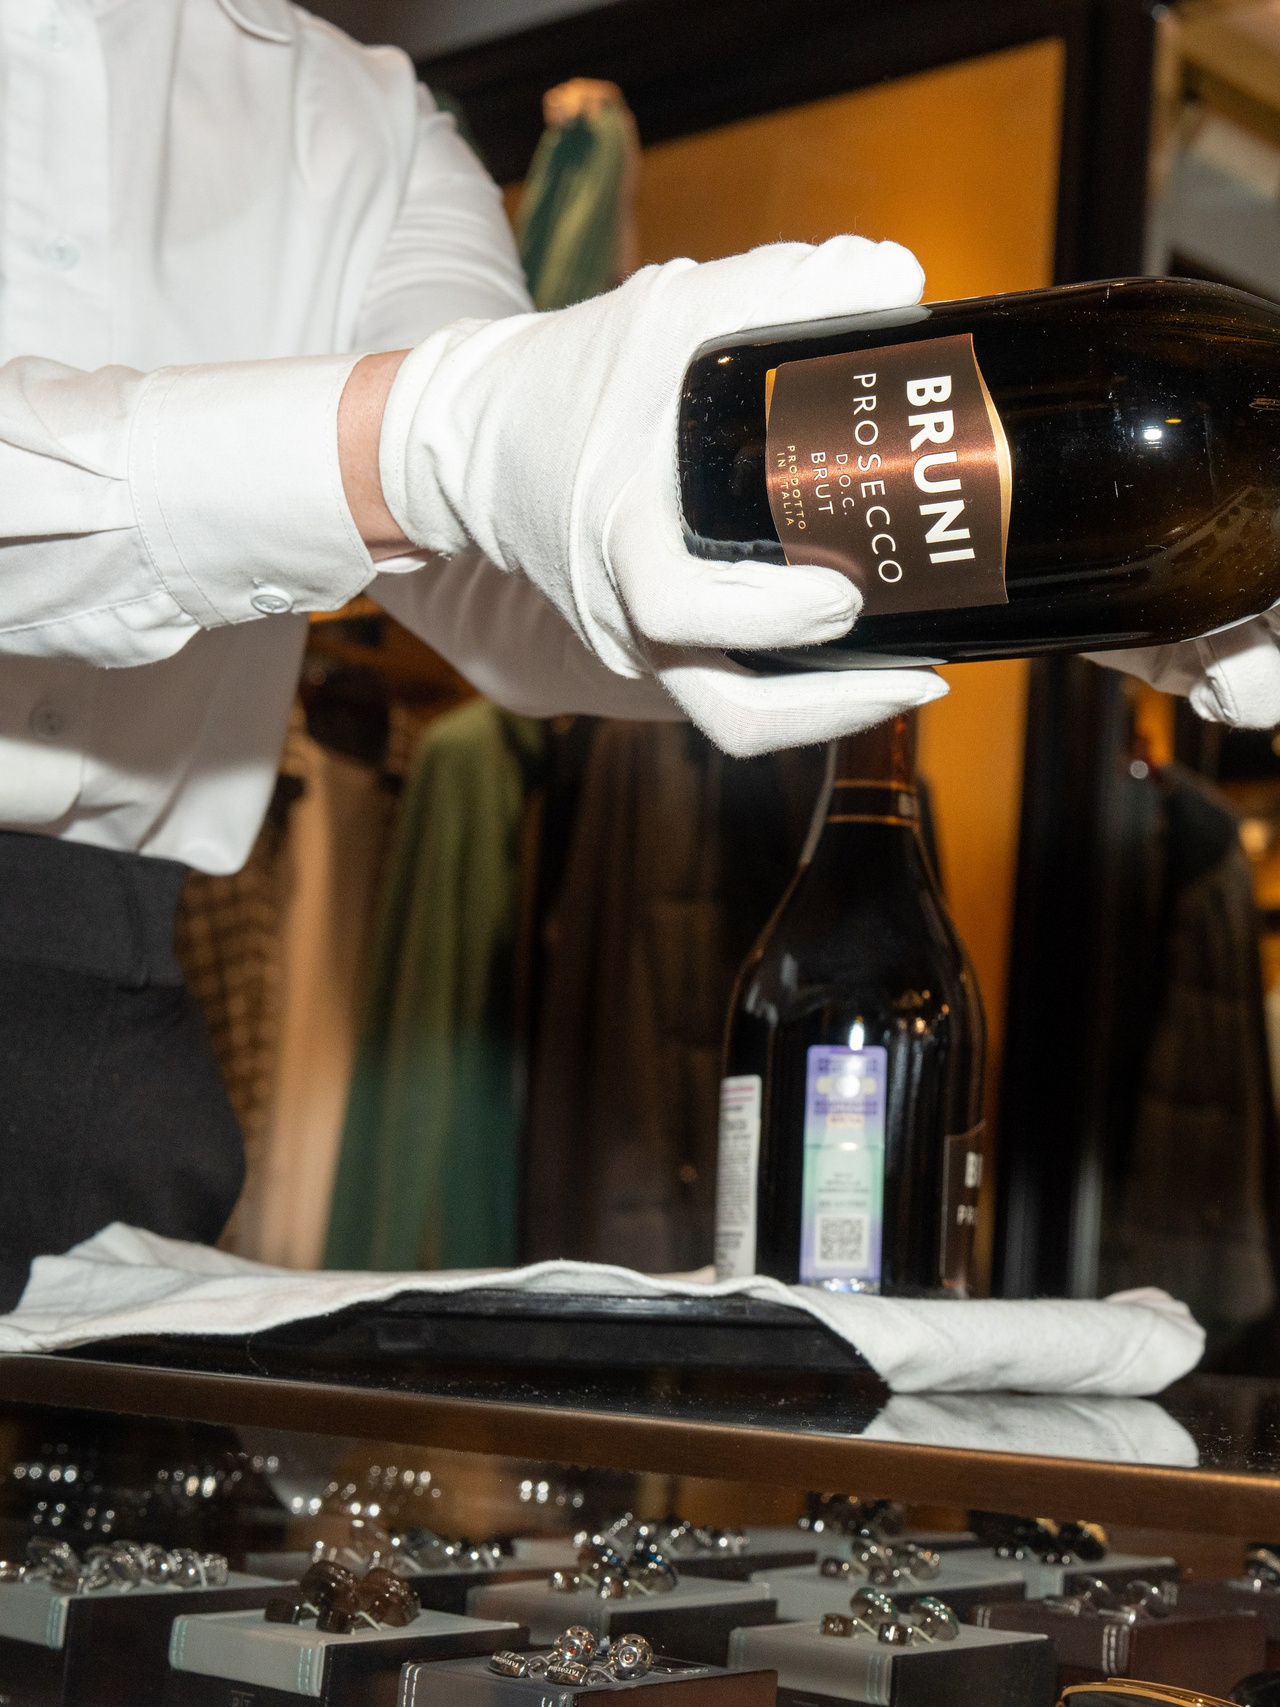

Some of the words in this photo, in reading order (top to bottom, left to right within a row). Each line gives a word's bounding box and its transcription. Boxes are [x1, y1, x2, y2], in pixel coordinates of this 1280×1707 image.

[777, 452, 786, 467] IN
[787, 445, 807, 529] PRODOTTO
[810, 452, 834, 515] BRUT
[853, 372, 903, 583] PROSECCO
[906, 375, 976, 564] BRUNI
[780, 476, 794, 526] ITALIA
